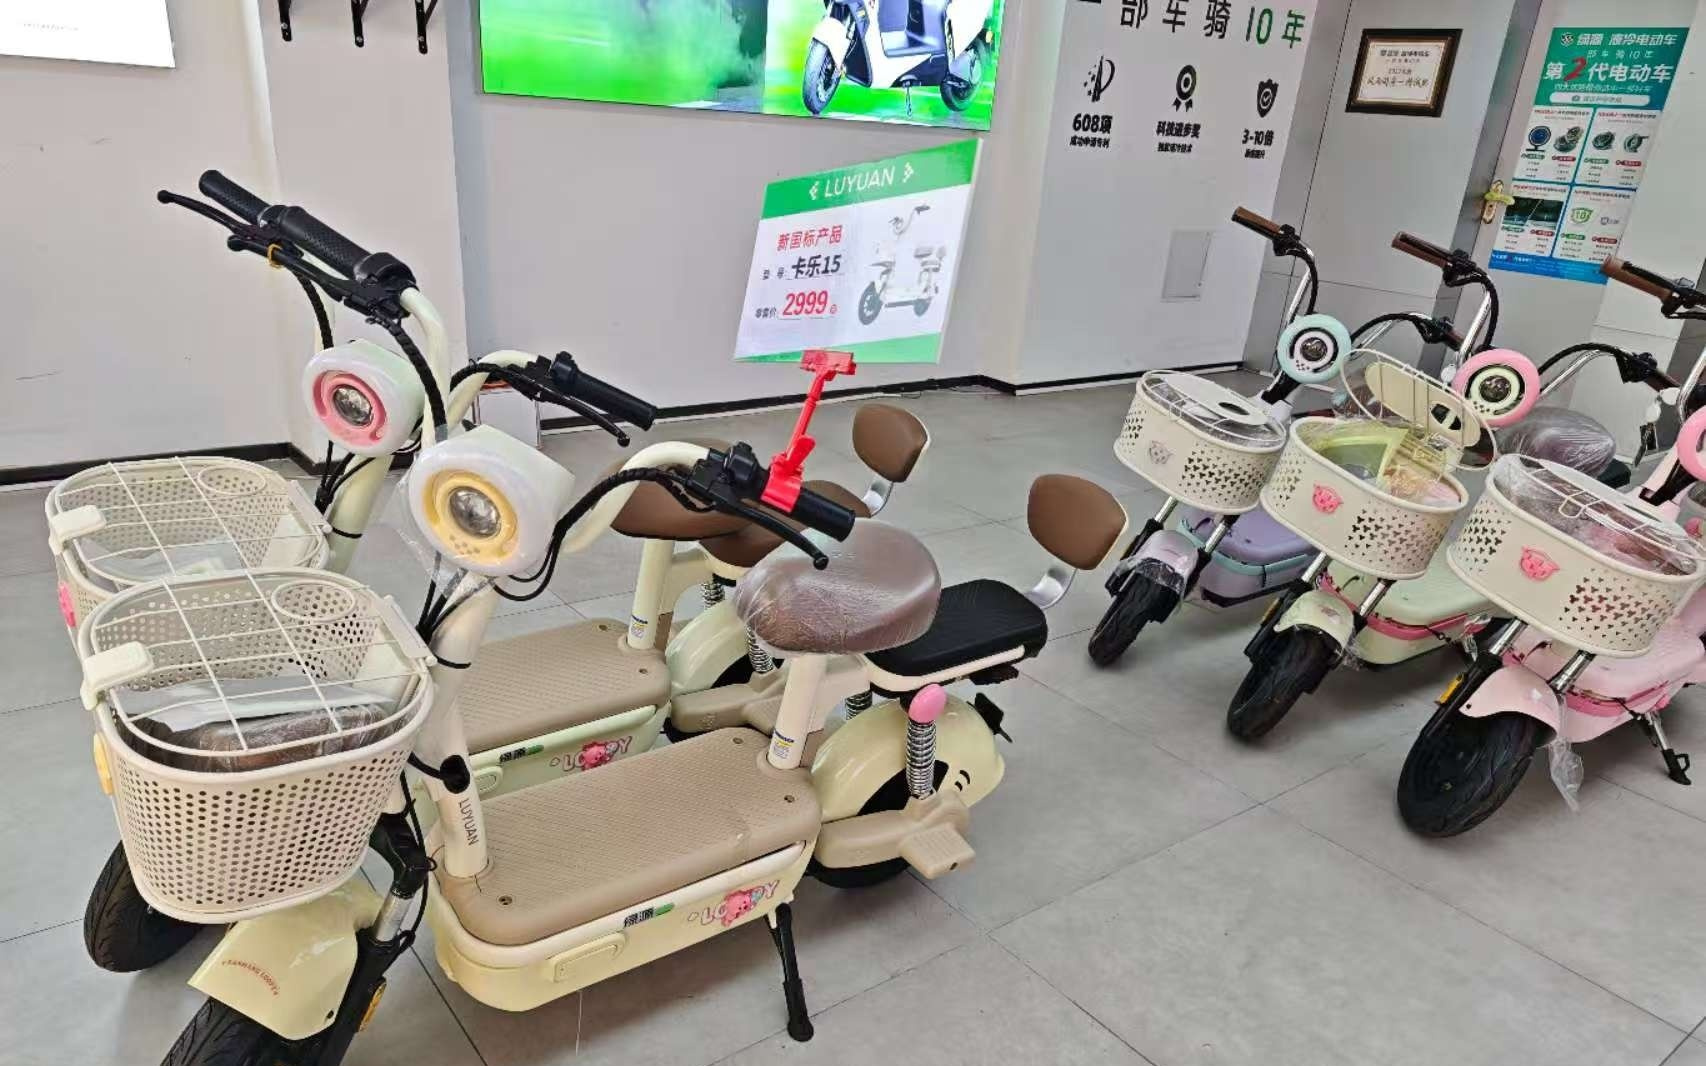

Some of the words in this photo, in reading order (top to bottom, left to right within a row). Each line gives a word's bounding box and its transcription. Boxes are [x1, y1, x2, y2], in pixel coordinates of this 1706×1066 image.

[1543, 56, 1674, 83] 第2代电动车
[1072, 113, 1113, 134] 608项
[1156, 121, 1202, 139] 科技进步奖
[1242, 129, 1274, 147] 3-10倍
[824, 165, 895, 198] LUYUAN
[776, 225, 843, 252] 新国标产品
[791, 254, 842, 280] 卡乐15
[458, 797, 479, 846] LUYUAN
